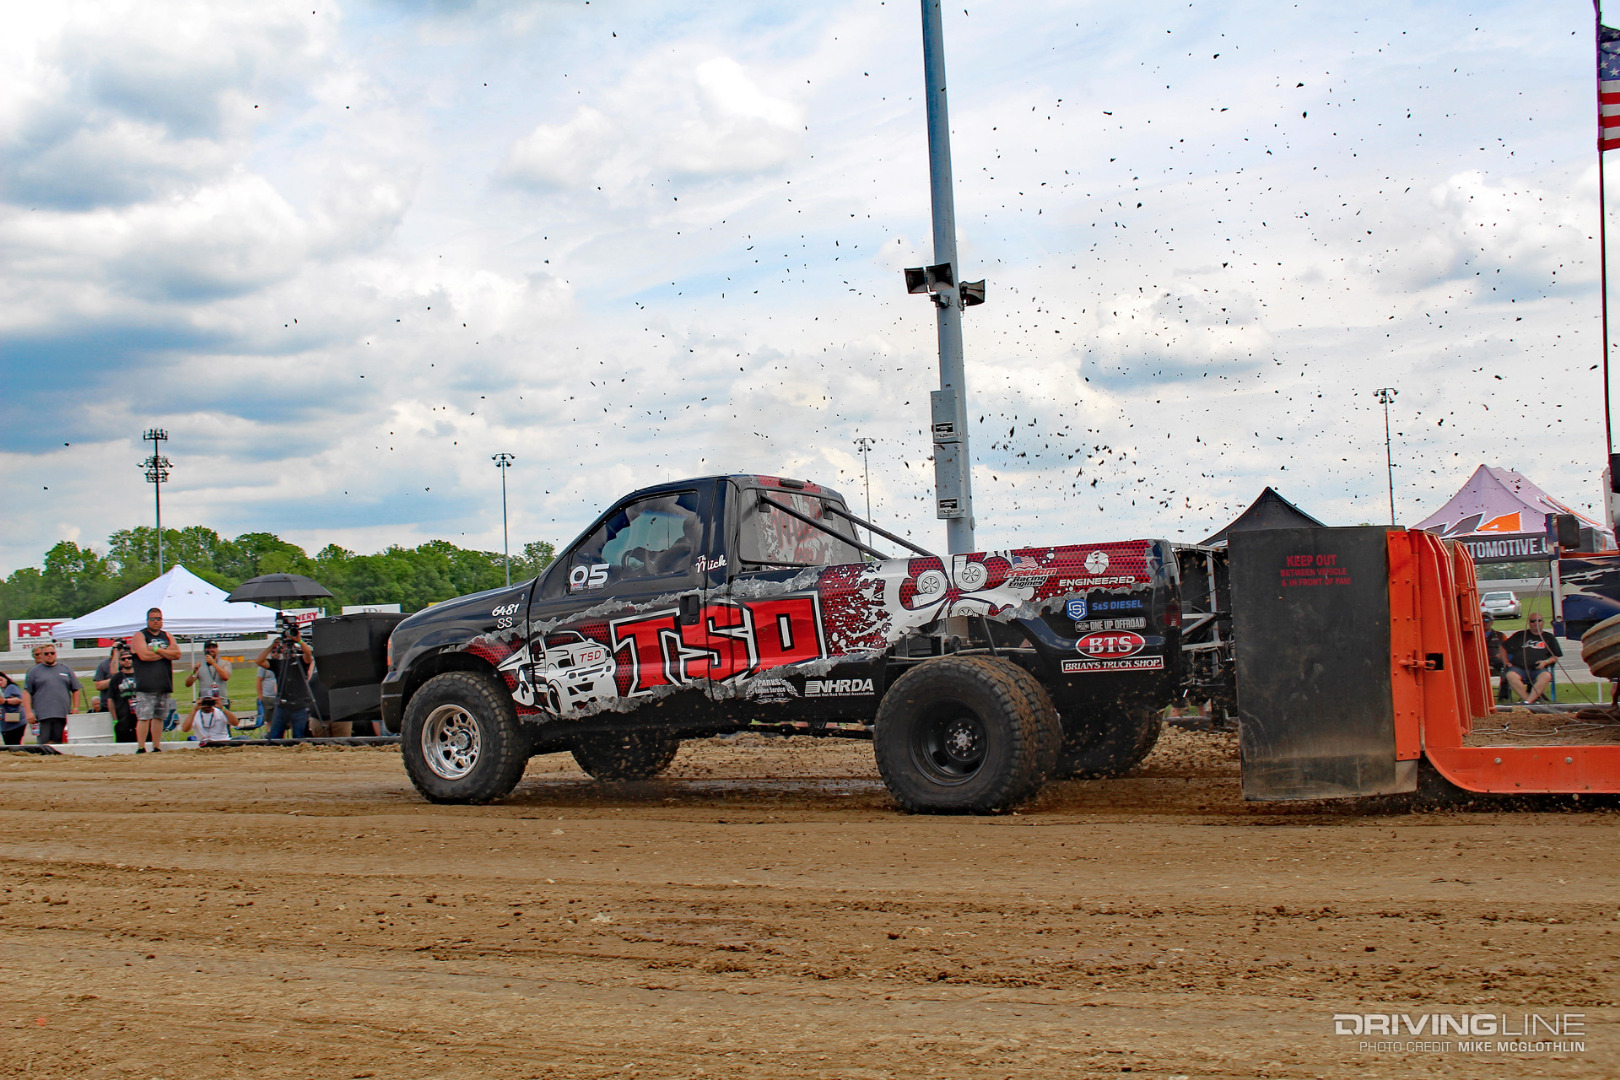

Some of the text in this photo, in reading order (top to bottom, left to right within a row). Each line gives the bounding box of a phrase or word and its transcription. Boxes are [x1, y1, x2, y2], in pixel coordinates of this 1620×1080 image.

[695, 554, 728, 573] Mick
[1286, 554, 1337, 567] KEEP OUT
[569, 563, 610, 586] 05
[1003, 567, 1058, 578] Freedom
[1280, 567, 1347, 577] BETWEEN VEHICLE
[1008, 580, 1043, 588] Engines
[1012, 575, 1047, 583] Racing
[1059, 576, 1136, 587] ENGINEERED
[1289, 579, 1298, 587] IN
[1299, 578, 1323, 586] FRONT
[1324, 577, 1334, 585] OF
[491, 603, 520, 617] 6481
[1091, 599, 1143, 611] S&S DIESEL
[496, 617, 513, 629] SS
[1090, 618, 1145, 630] ONE UP OFFROAD
[610, 591, 827, 697] TSD
[1088, 635, 1133, 654] BTS
[579, 649, 603, 664] TSD
[1065, 661, 1101, 671] BRIAN'S
[1102, 660, 1132, 670] TRUCK
[816, 678, 875, 693] NHRDA
